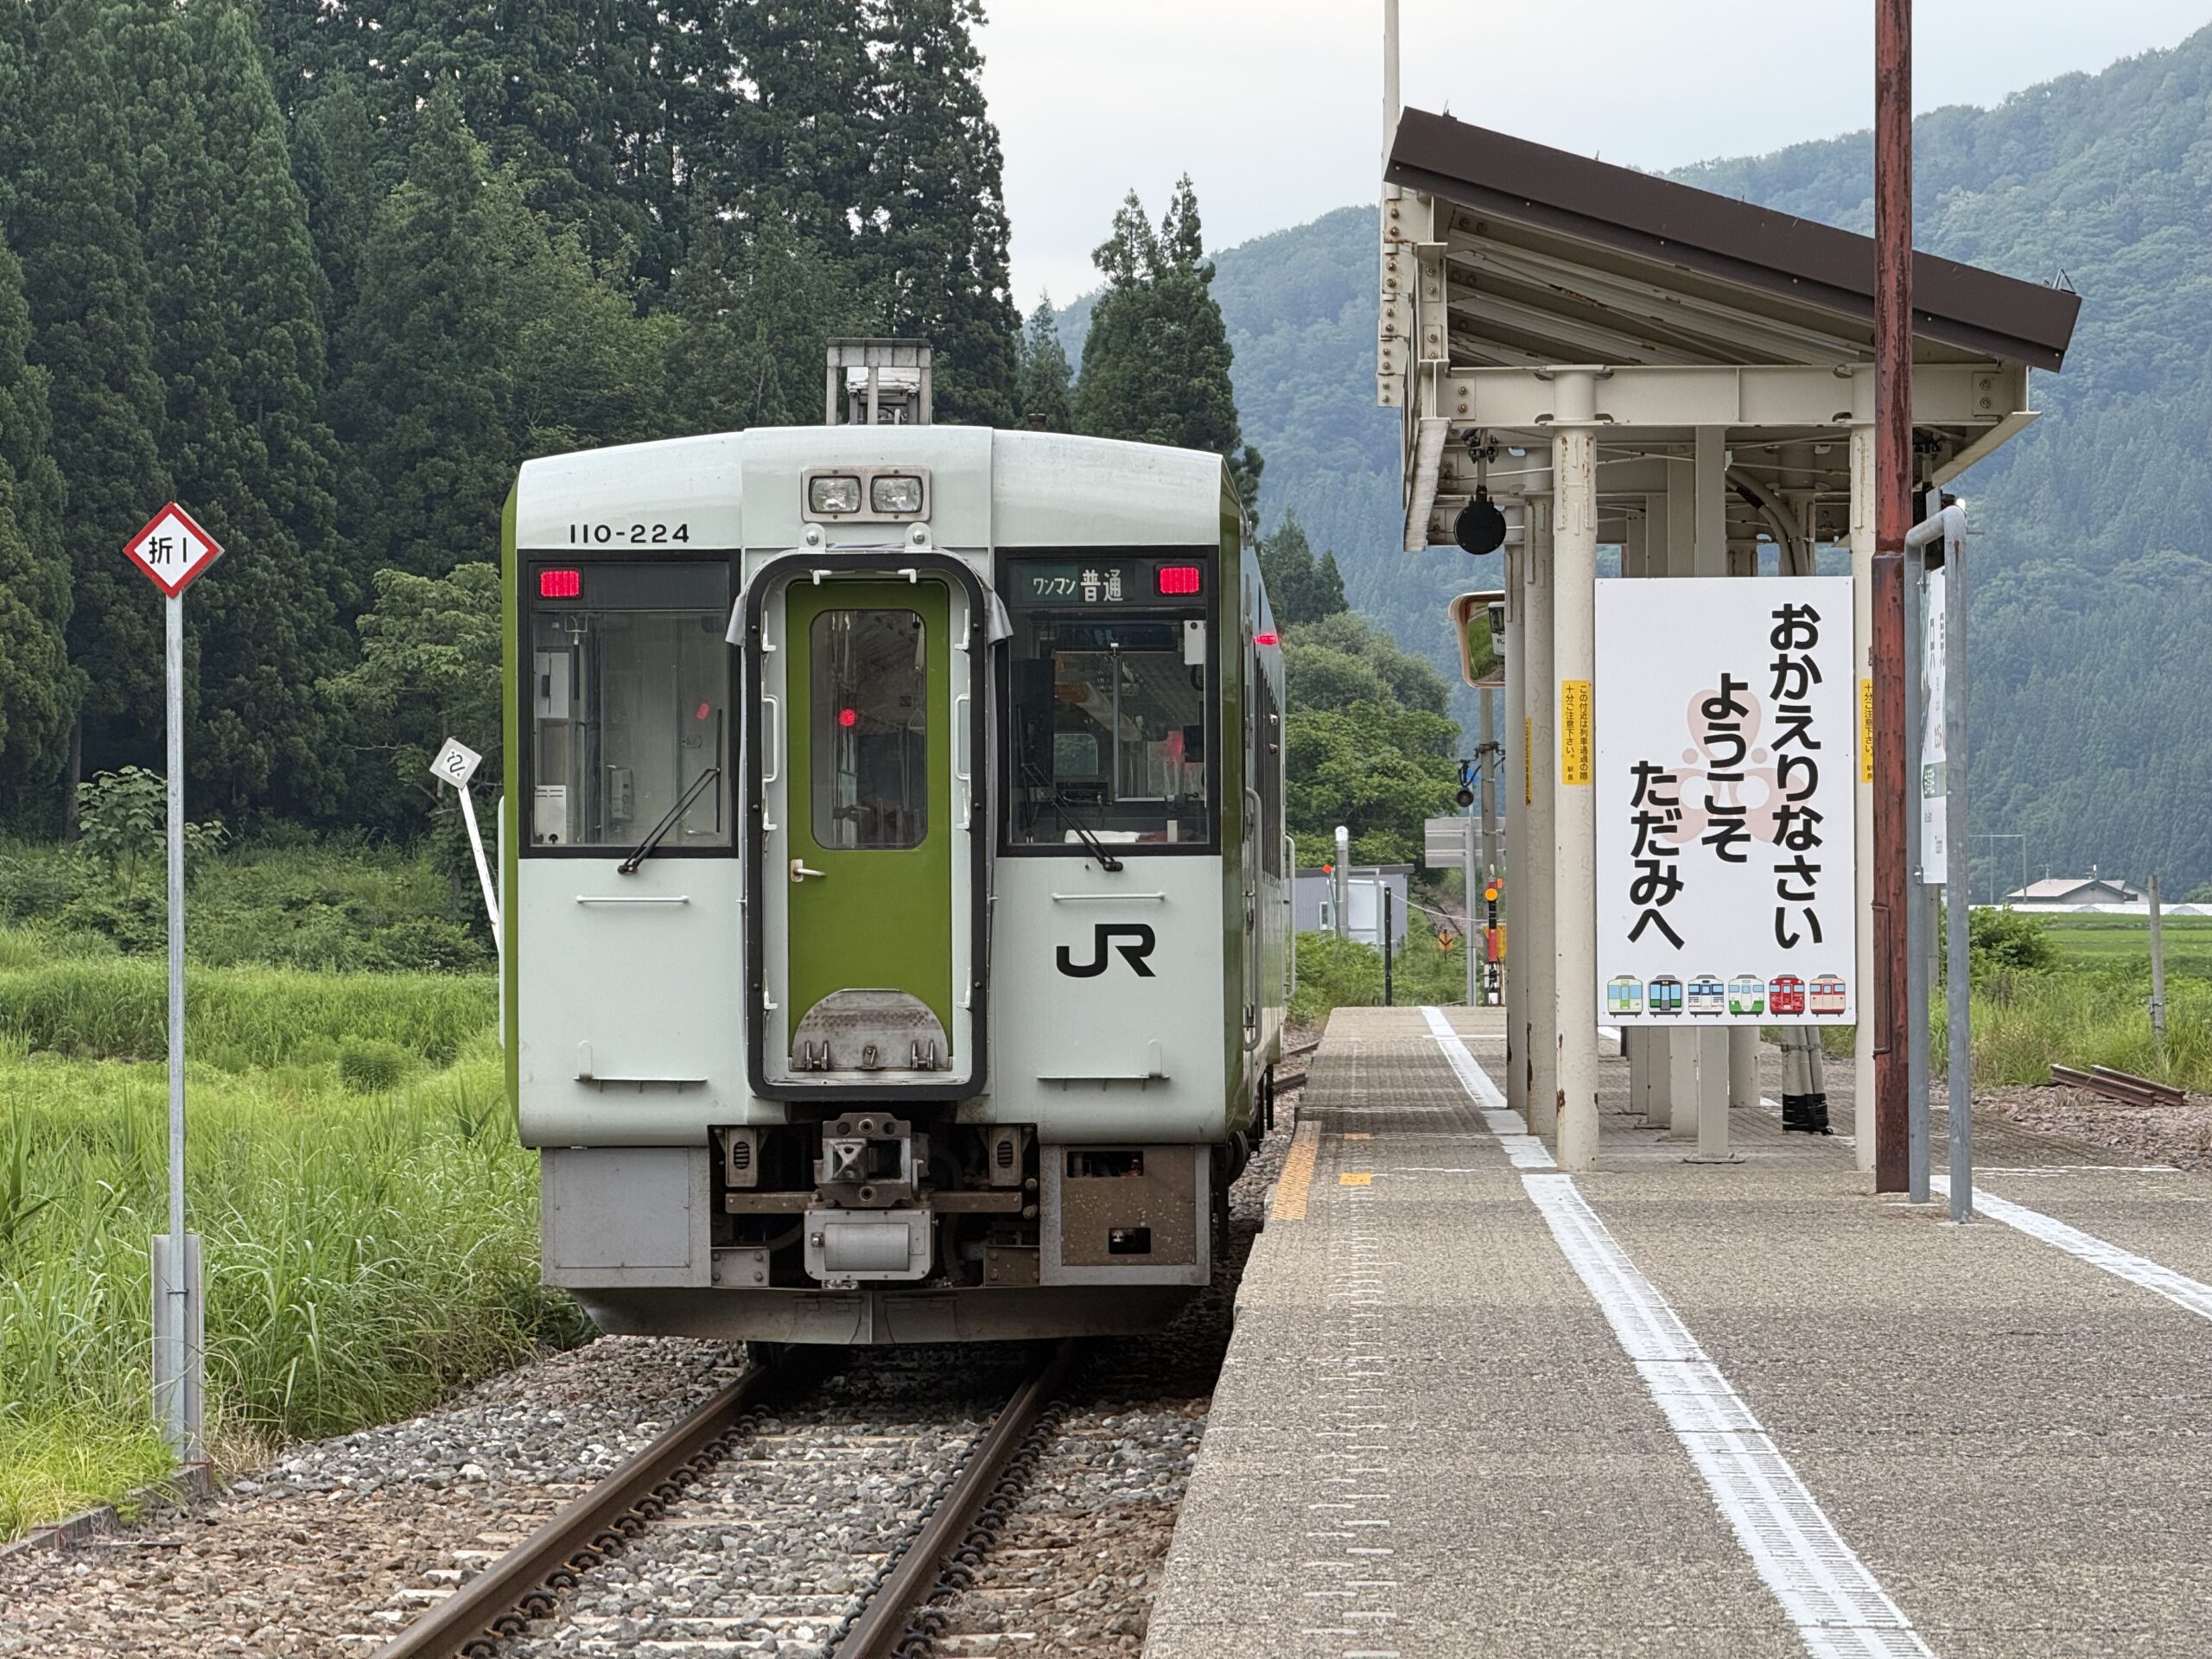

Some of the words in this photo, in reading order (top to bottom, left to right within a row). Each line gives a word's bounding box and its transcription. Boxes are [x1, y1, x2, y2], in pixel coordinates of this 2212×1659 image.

[570, 524, 690, 543] 110-224
[1033, 578, 1077, 594] ワンマン
[1080, 569, 1123, 601] 普通
[1701, 672, 1751, 863] ようこそ
[1770, 603, 1823, 949] おかえりなさい
[1627, 760, 1685, 950] ただみへ
[1056, 924, 1156, 978] JR
